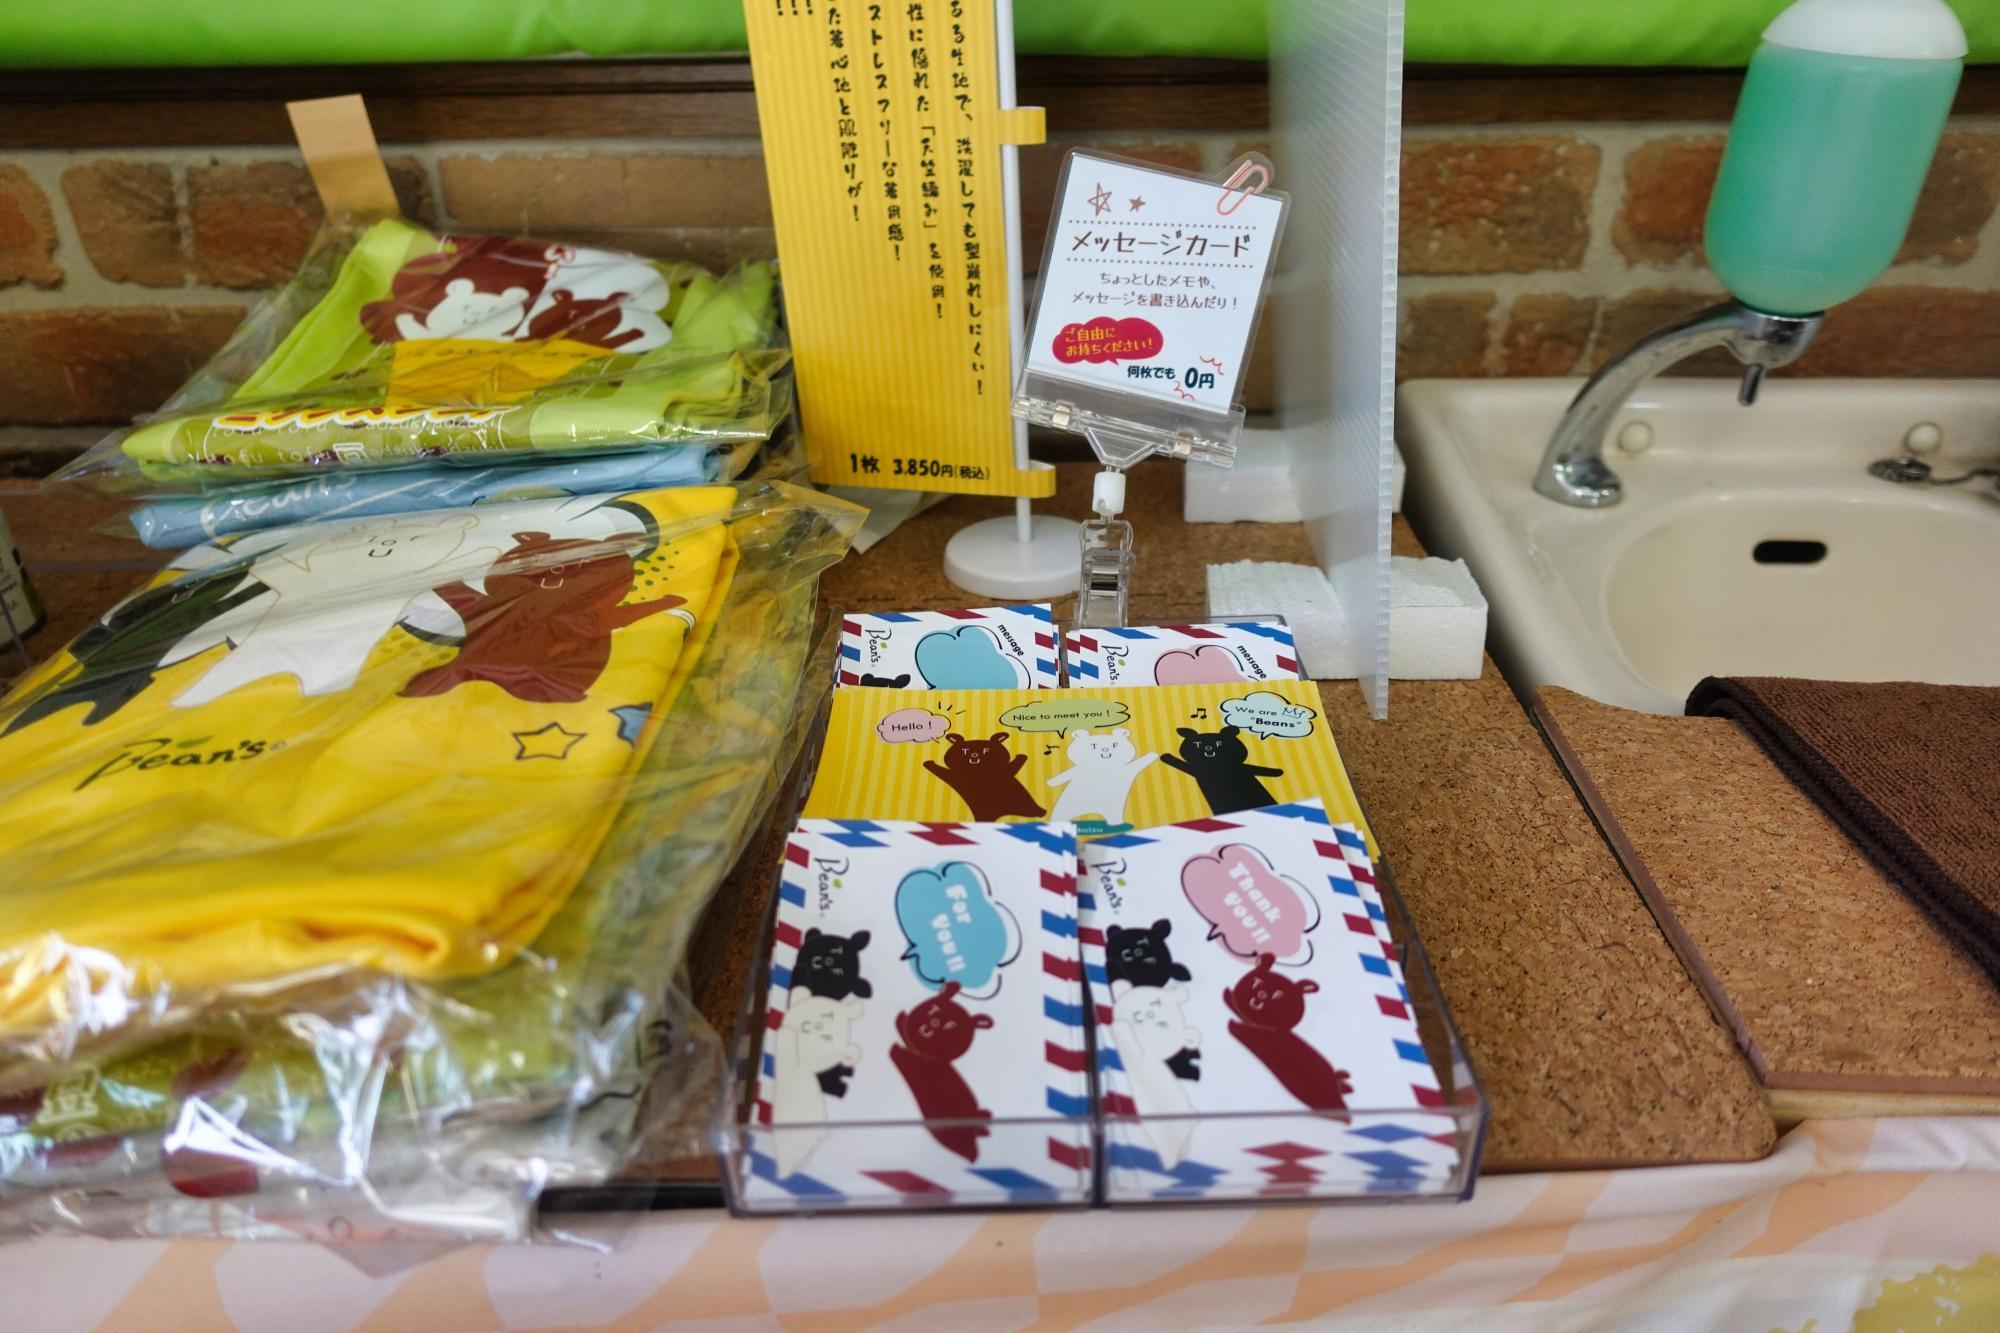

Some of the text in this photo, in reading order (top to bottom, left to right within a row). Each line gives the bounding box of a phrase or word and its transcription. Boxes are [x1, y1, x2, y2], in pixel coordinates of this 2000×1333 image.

[1071, 229, 1251, 258] メッセージカード
[1100, 272, 1216, 289] ちょっとしたメモや、
[1072, 291, 1238, 310] メッセージを書き込んだり！
[1065, 326, 1116, 342] ご自由に
[1066, 337, 1153, 357] お持ちください！
[1127, 365, 1215, 389] 何枚でも 0円
[850, 453, 880, 473] 1枚
[865, 626, 892, 664] Bean's
[997, 623, 1025, 656] message
[1101, 644, 1129, 681] Bean's
[1237, 644, 1267, 680] message
[1013, 713, 1036, 721] Nice
[1054, 711, 1080, 719] meet
[1235, 705, 1255, 714] We
[892, 723, 923, 732] Hello
[814, 857, 849, 911] Bean's
[1091, 858, 1127, 914] Bean's
[1227, 861, 1281, 924] Thank
[945, 884, 971, 925] For
